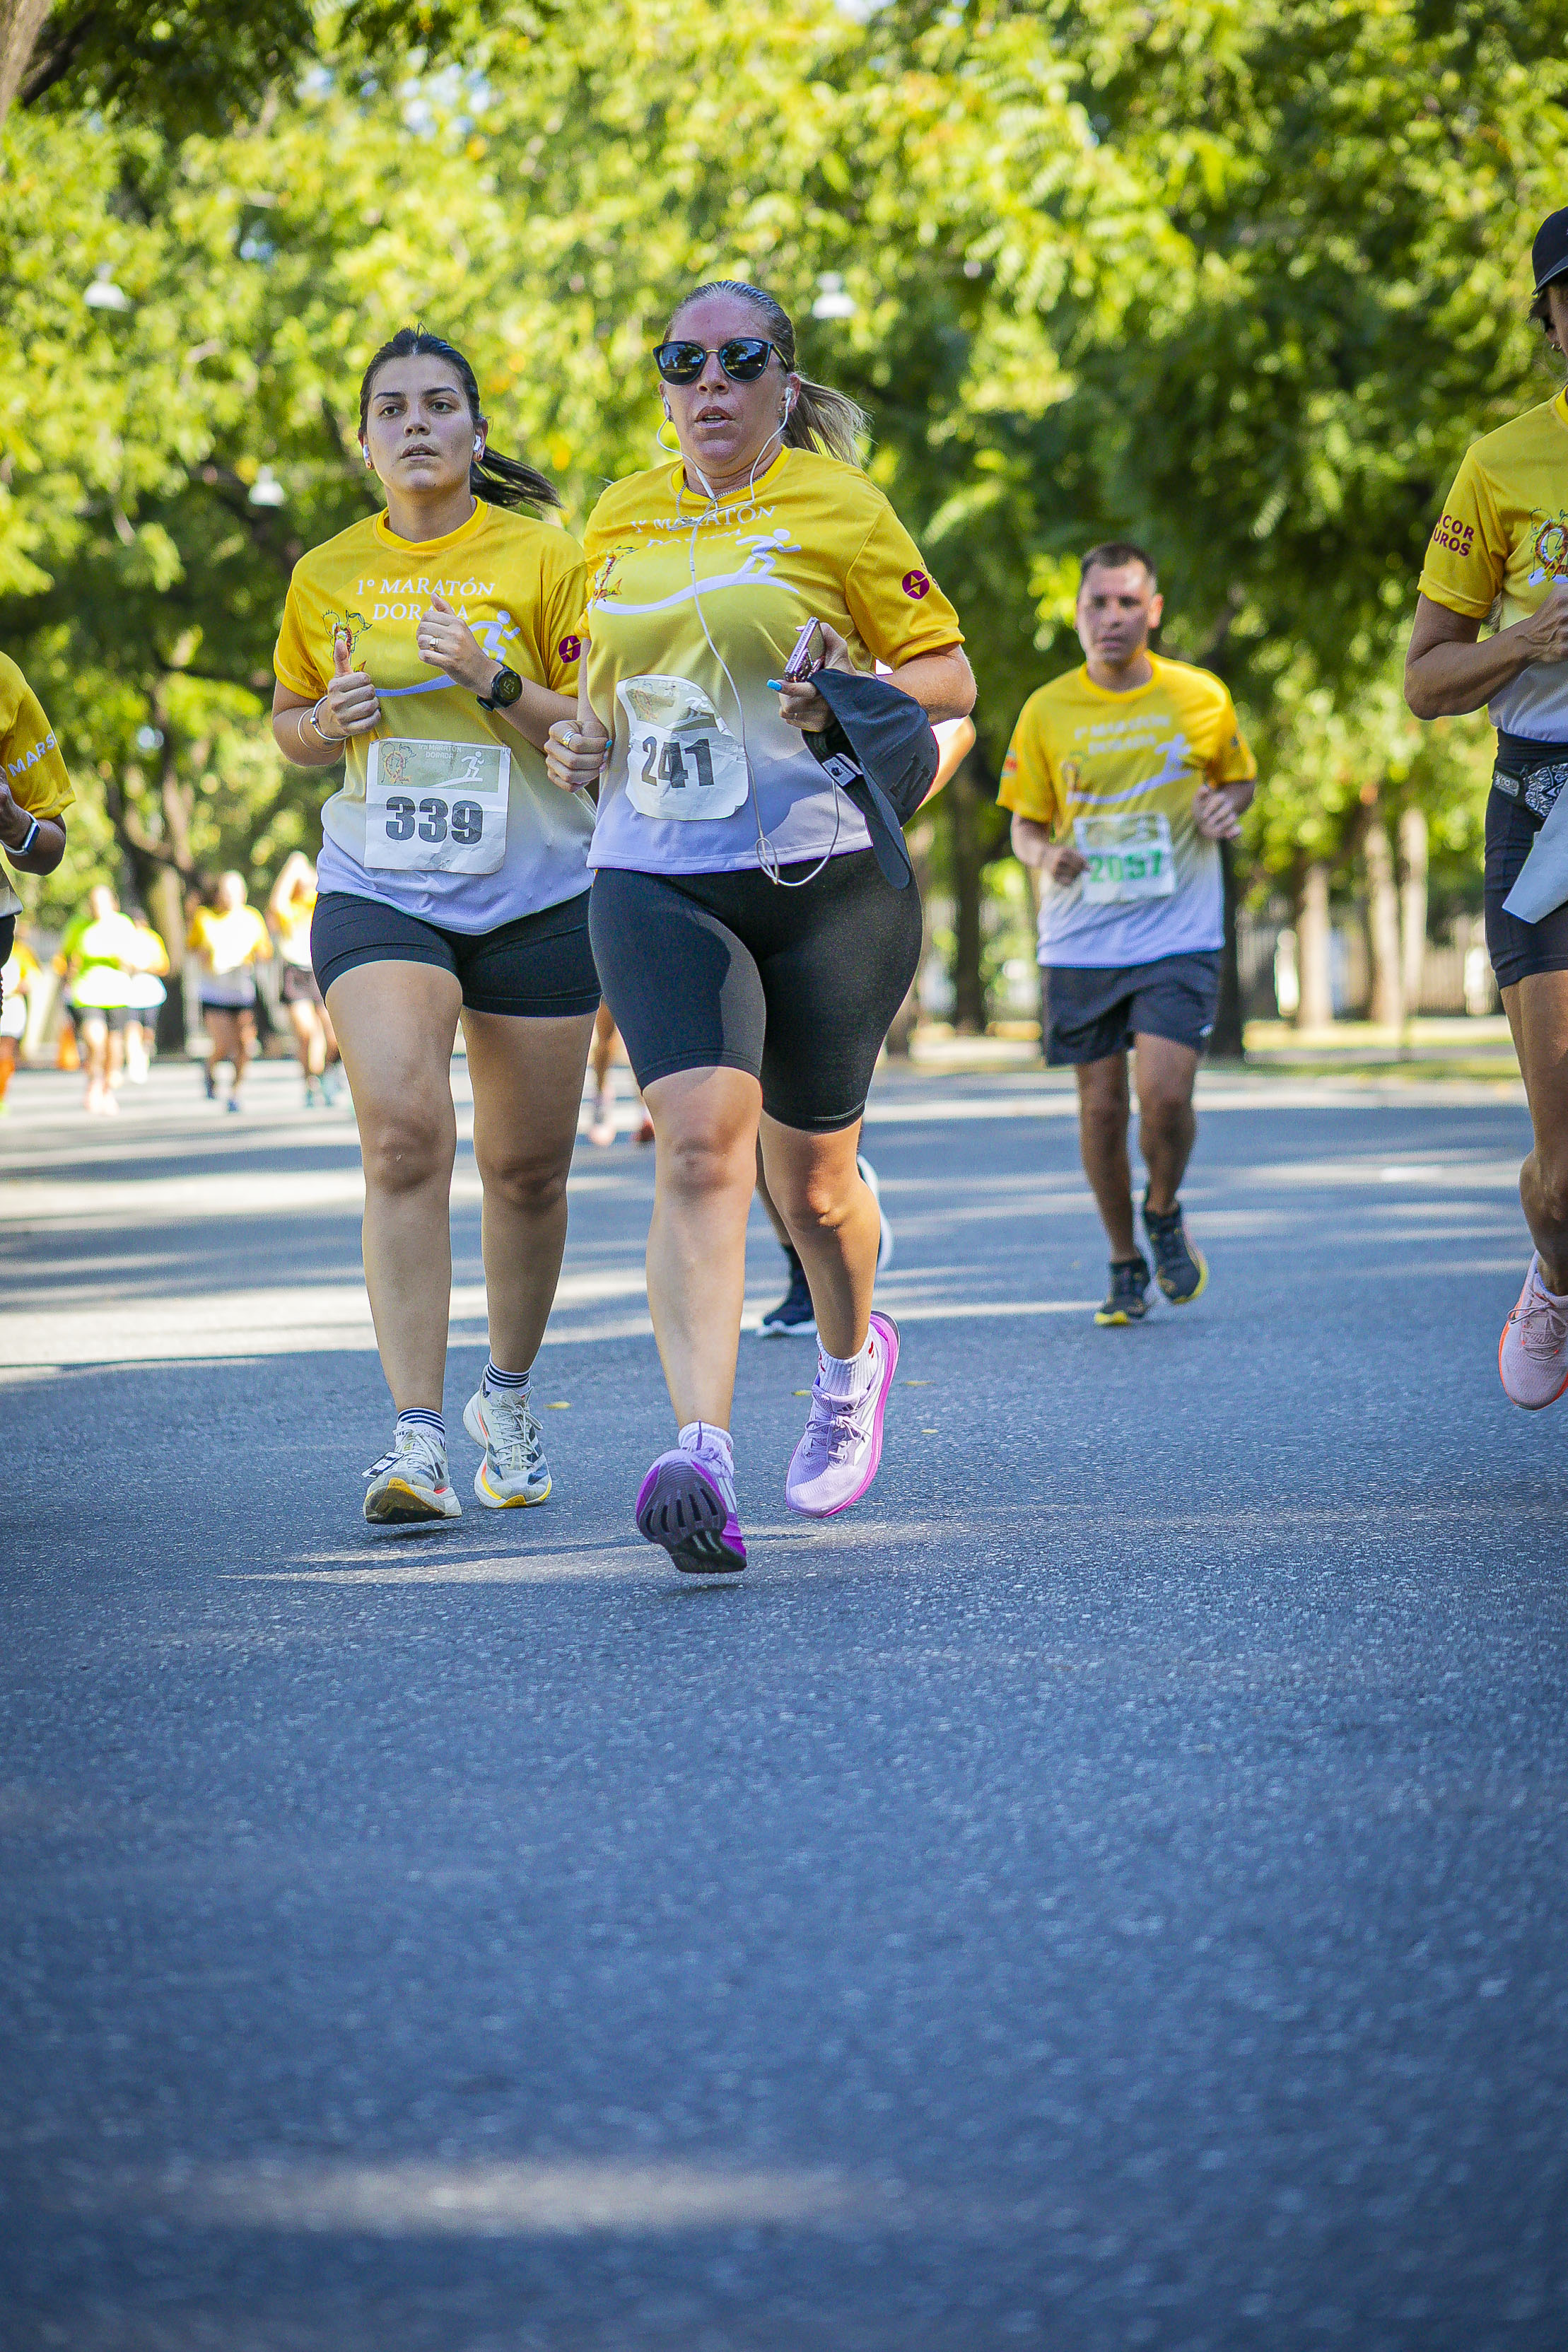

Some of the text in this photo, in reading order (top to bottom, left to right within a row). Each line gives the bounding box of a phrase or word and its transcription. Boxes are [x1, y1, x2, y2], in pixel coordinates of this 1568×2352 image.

[653, 503, 777, 532] MAATÓN
[379, 577, 496, 596] MARATÓN
[373, 604, 469, 620] DORA
[641, 736, 715, 788] 241
[386, 796, 484, 845] 339
